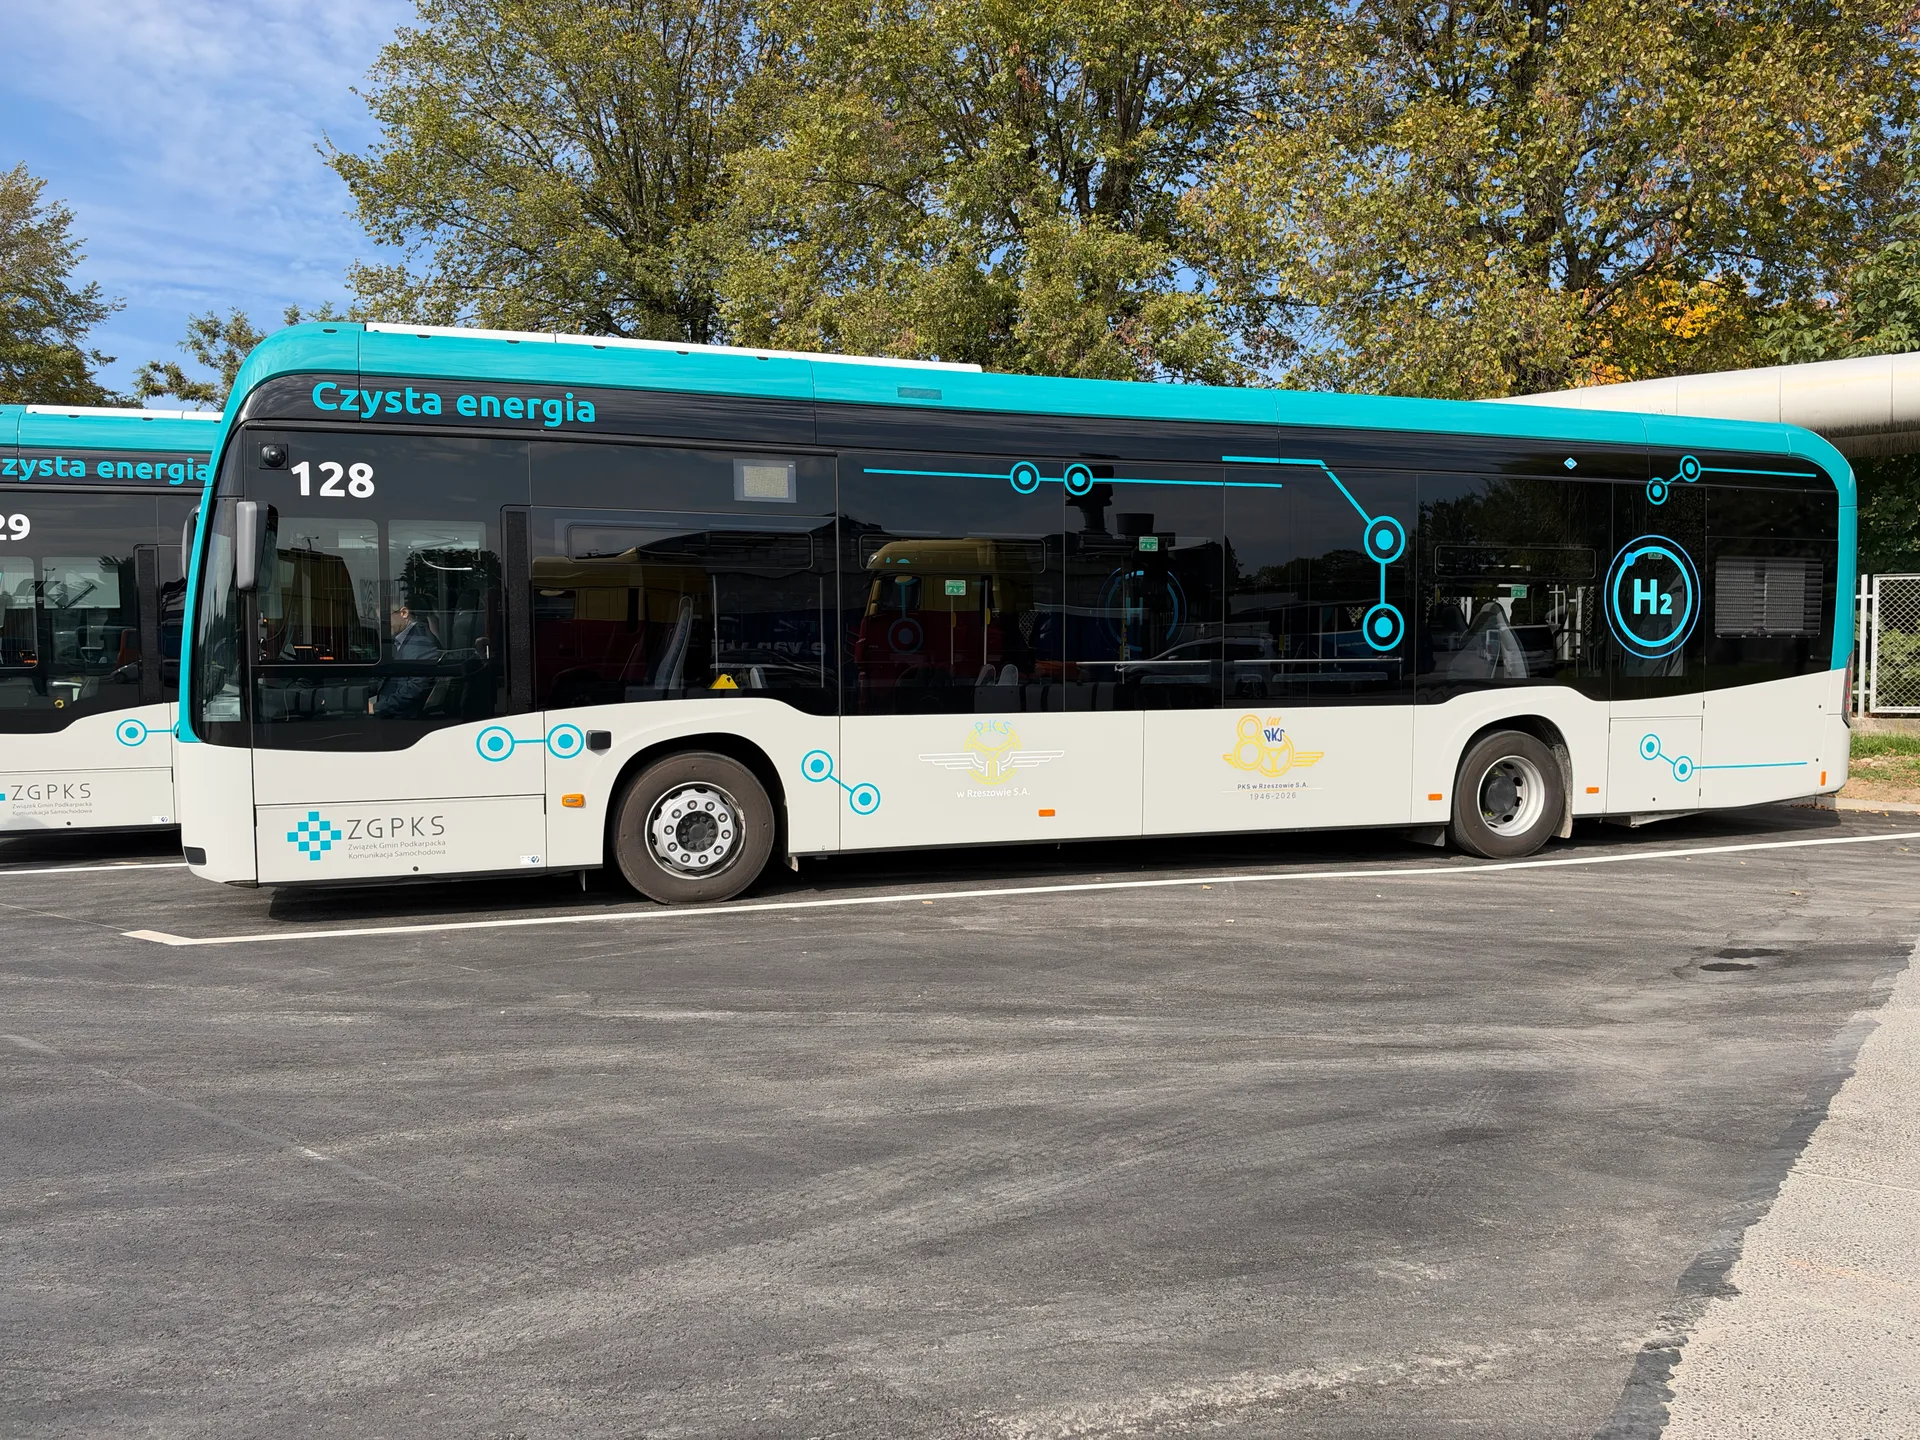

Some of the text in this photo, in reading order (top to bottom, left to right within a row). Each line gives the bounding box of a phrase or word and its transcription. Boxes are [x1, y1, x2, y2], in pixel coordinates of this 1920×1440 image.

[312, 382, 596, 427] Czysta energia
[97, 457, 210, 485] energia
[291, 461, 375, 498] 128
[974, 720, 1012, 735] PKS
[1263, 727, 1285, 742] PKS
[10, 783, 91, 801] ZGPKS
[967, 788, 1011, 798] Rzeszowie
[1013, 787, 1031, 796] S.A.
[1250, 792, 1297, 800] 1946-2026
[347, 815, 445, 840] ZGPKS
[348, 843, 377, 851] Związek
[400, 840, 446, 848] Podkarpacka
[348, 849, 446, 860] Komunikacja Samochodowa
